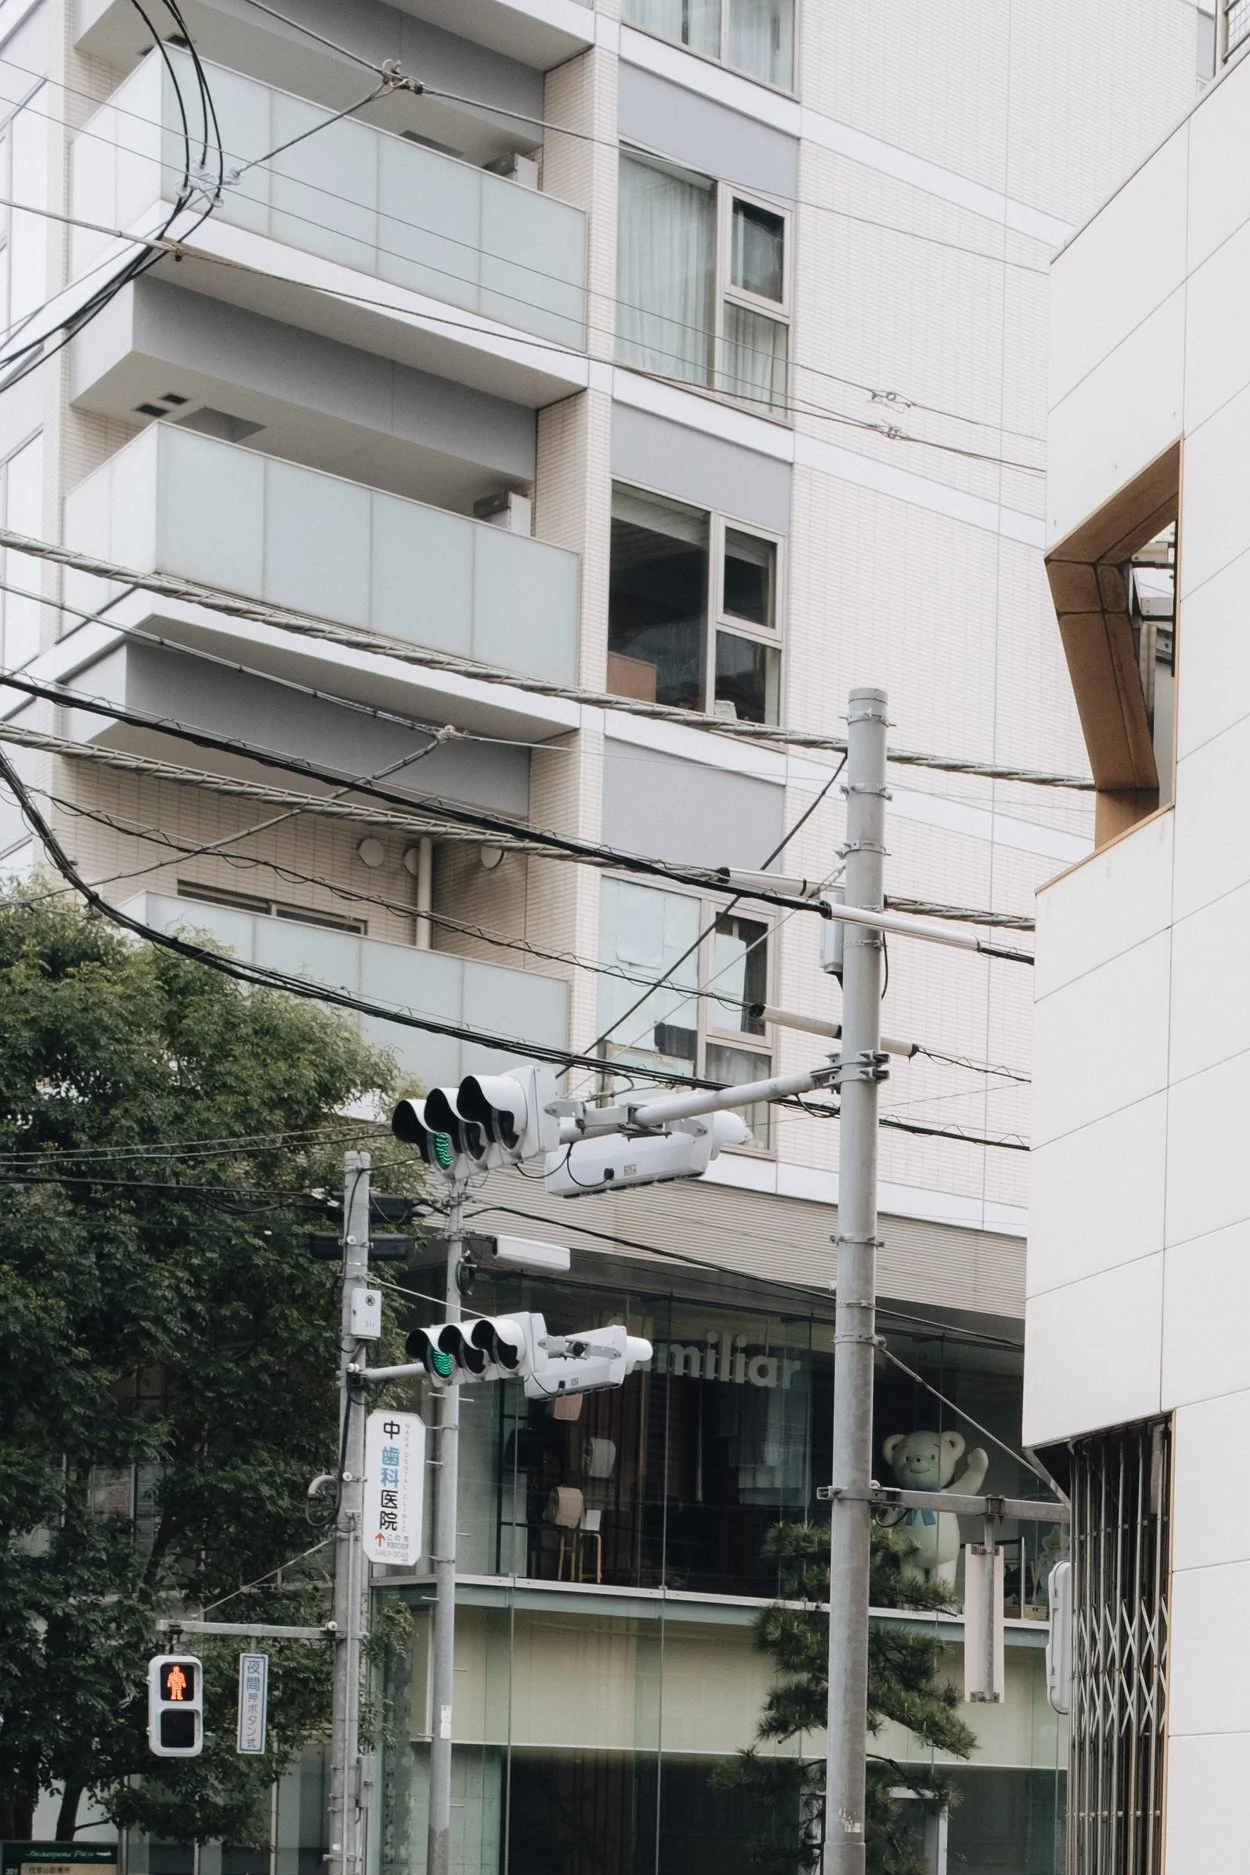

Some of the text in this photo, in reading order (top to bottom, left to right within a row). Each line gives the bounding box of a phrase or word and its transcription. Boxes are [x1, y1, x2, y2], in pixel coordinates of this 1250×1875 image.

[633, 1330, 801, 1389] miliar
[379, 1420, 401, 1531] 中歯科医院
[246, 1660, 261, 1749] 夜間押ボタン式
